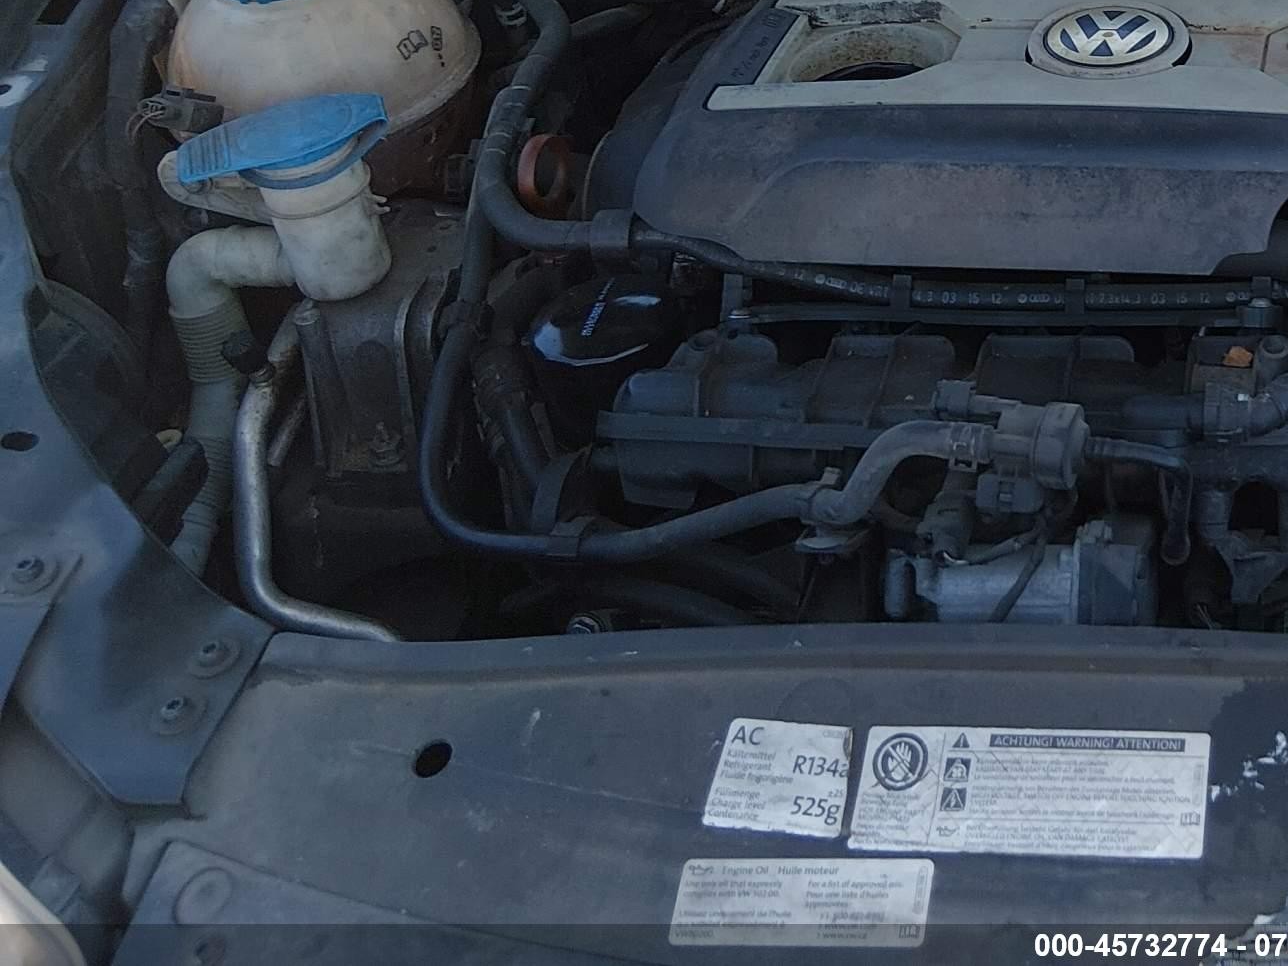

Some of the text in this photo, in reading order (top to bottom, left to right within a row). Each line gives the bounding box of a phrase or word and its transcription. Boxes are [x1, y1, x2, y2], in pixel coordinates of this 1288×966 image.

[731, 725, 764, 745] AC
[994, 736, 1182, 750] ACHTUNG! WARNING! ATTENTION!
[792, 755, 848, 778] R134a
[790, 796, 841, 826] 525g
[722, 865, 840, 876] Engine Oil Huile moteur
